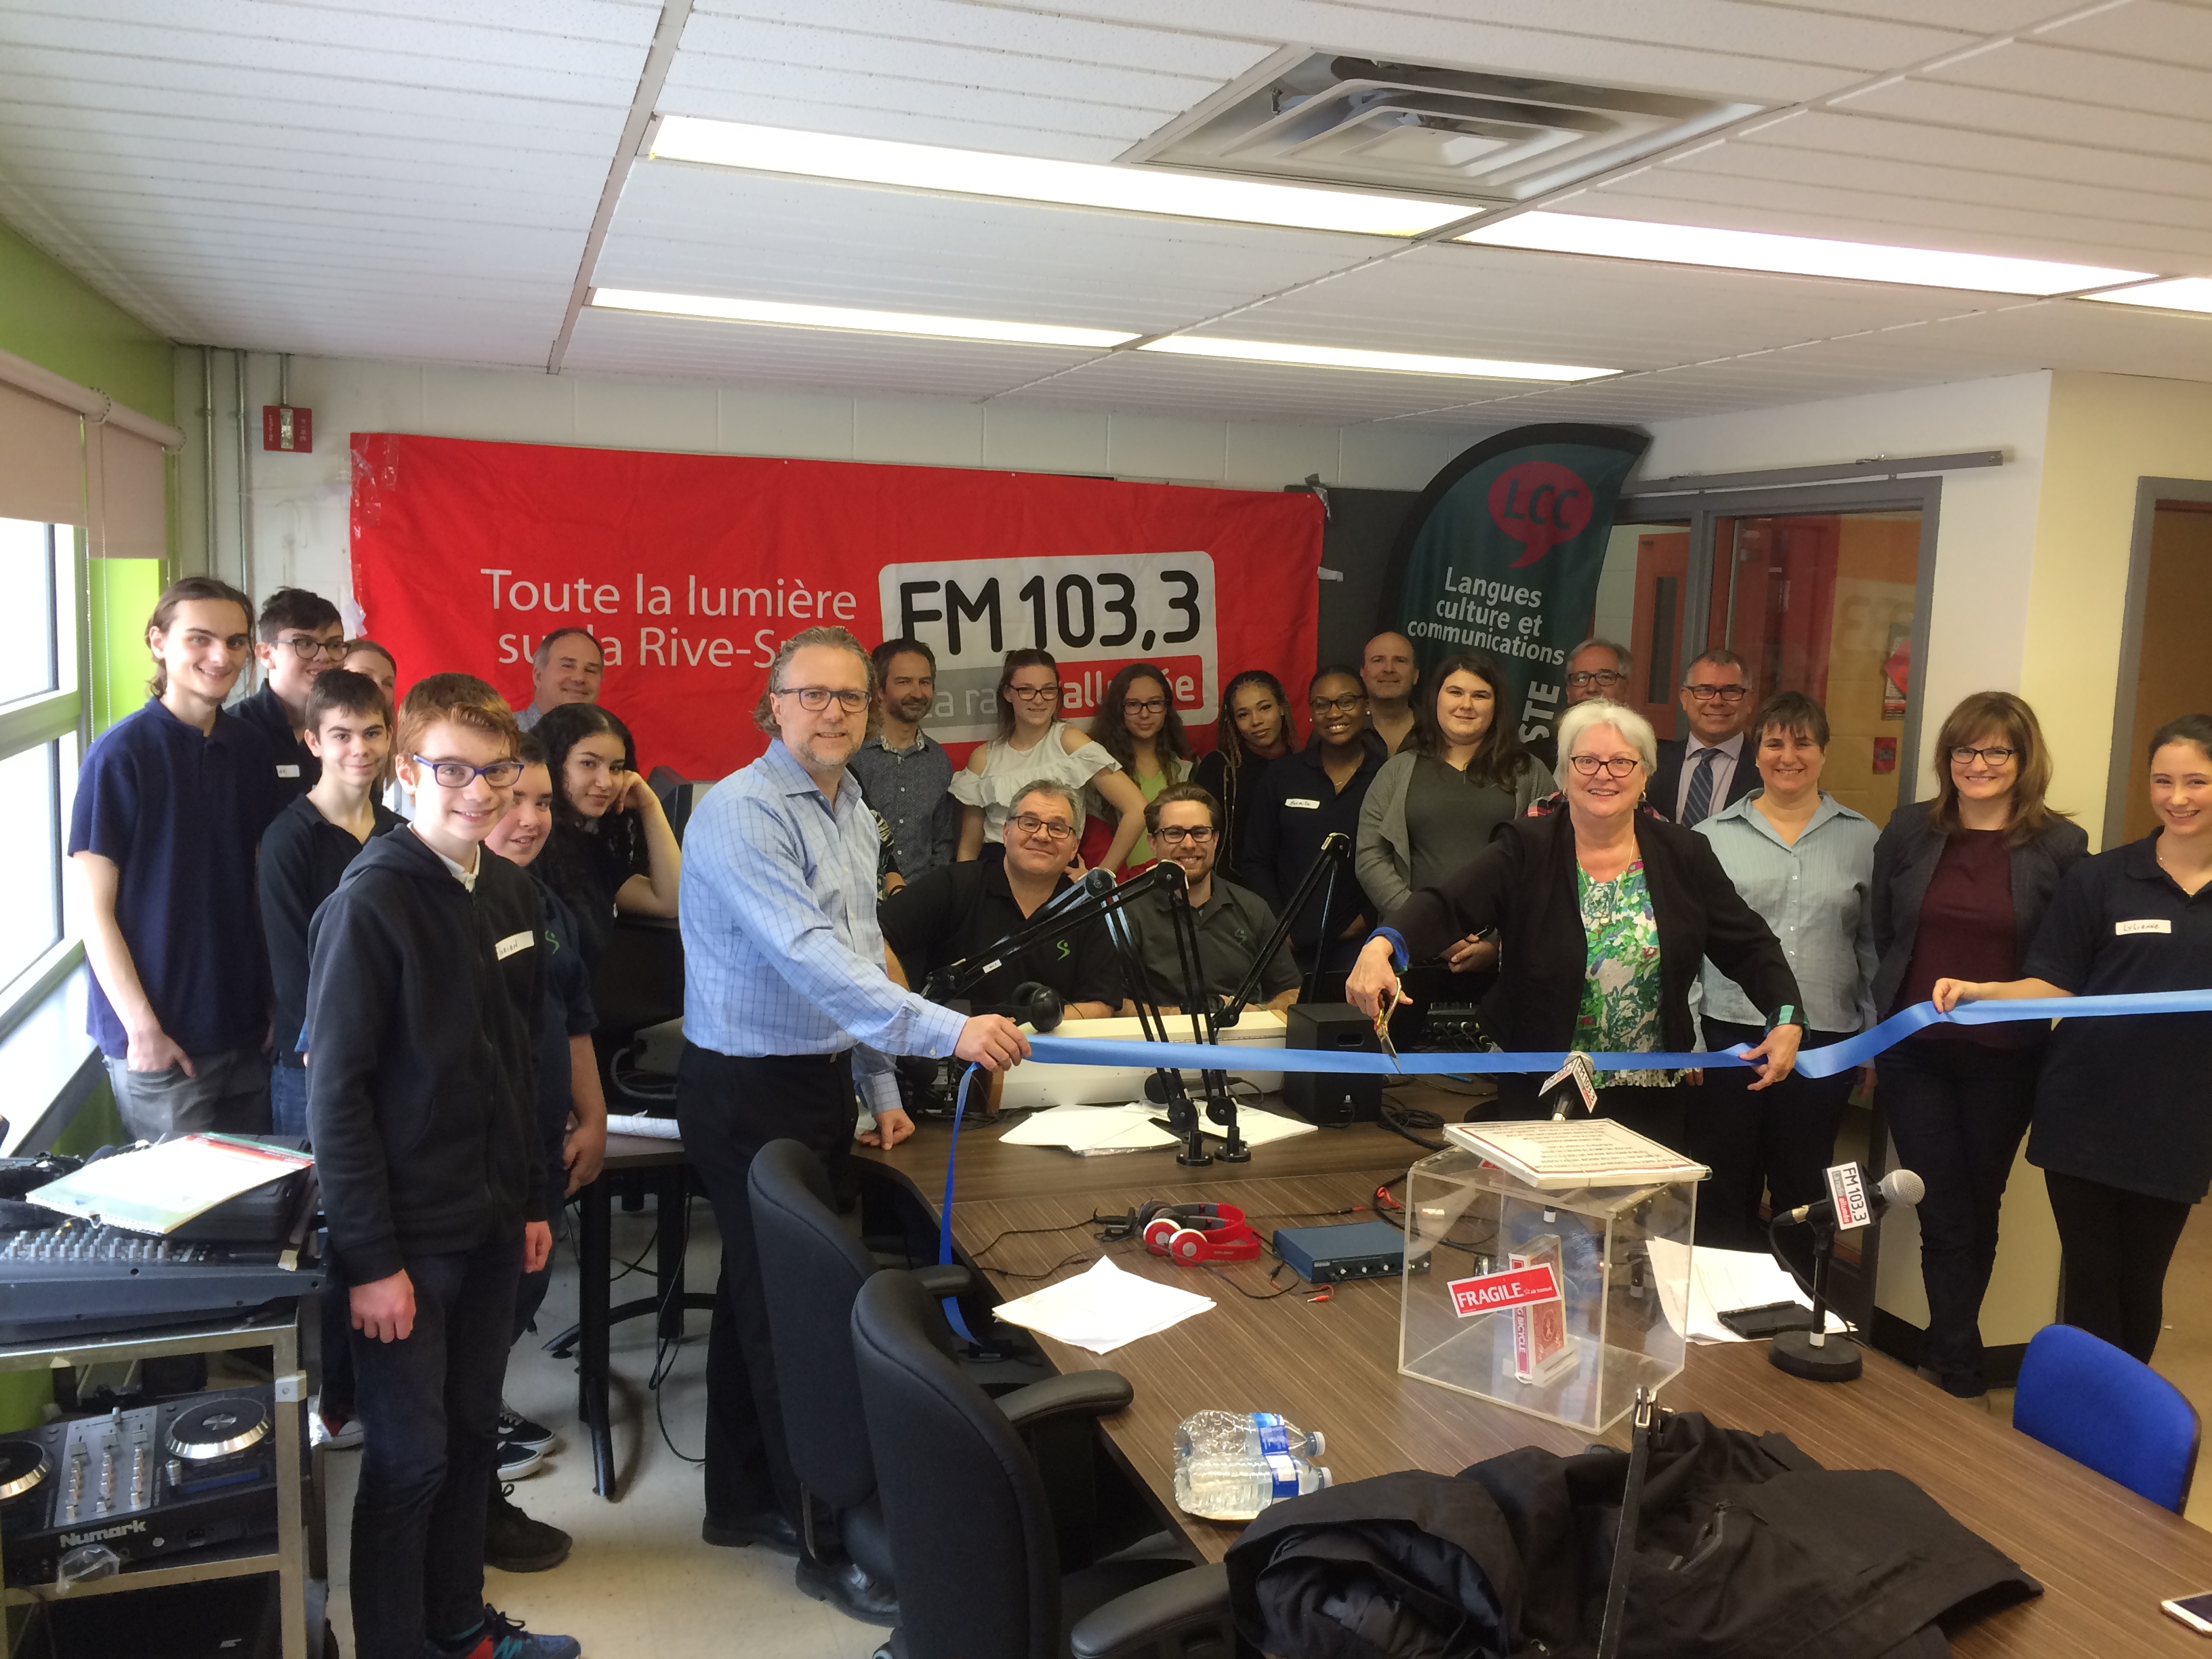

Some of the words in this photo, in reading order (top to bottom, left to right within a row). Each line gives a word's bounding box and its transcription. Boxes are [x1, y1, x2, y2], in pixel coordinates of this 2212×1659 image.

[1503, 478, 1578, 531] LCC
[480, 568, 620, 613] Toute
[636, 573, 671, 615] la
[689, 575, 857, 620] lumière
[1444, 567, 1542, 609] Langues
[899, 577, 1003, 655] FM
[1019, 569, 1201, 651] 103,3
[1435, 596, 1509, 630] culture
[1518, 614, 1542, 638] et
[498, 632, 546, 664] su
[586, 623, 622, 666] a
[640, 626, 787, 668] Rive-S
[1407, 619, 1565, 665] communications
[1577, 1061, 1586, 1078] FM
[1843, 1167, 1859, 1187] FM
[1848, 1187, 1867, 1222] 103,3
[1456, 1282, 1524, 1309] FRAGILE
[1517, 1317, 1526, 1353] BICYCLE
[60, 1519, 147, 1548] Numark
